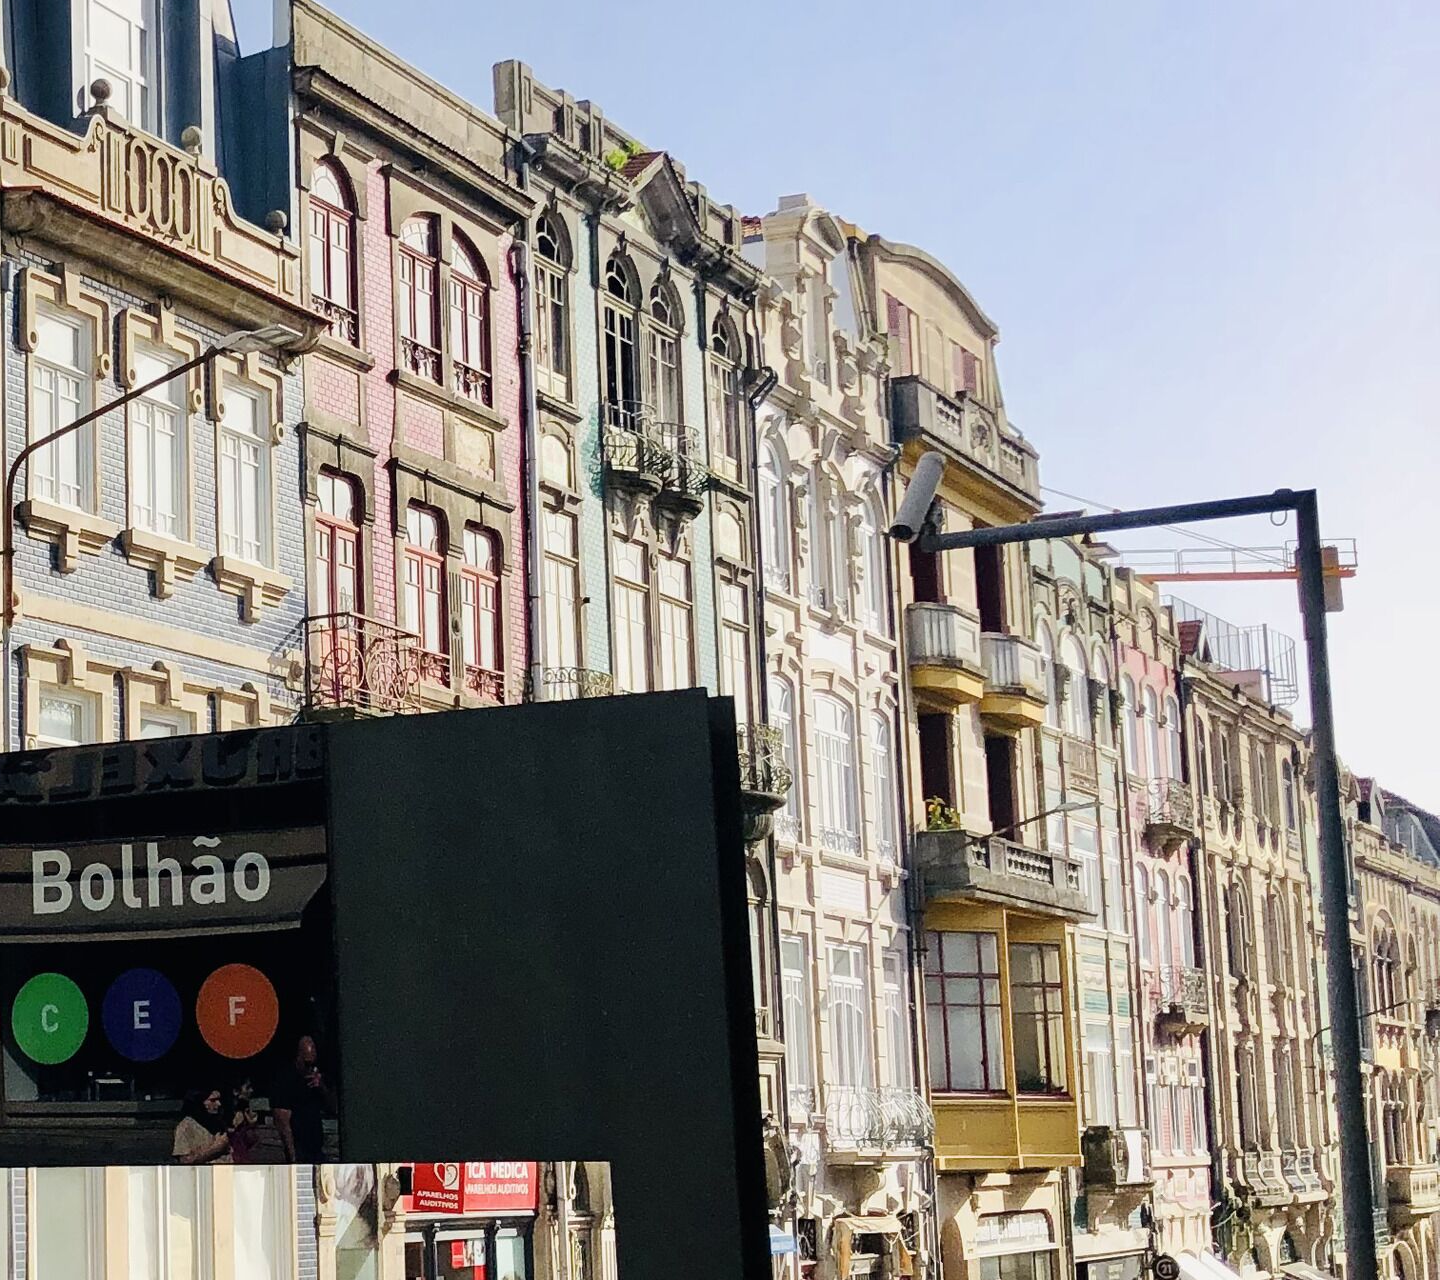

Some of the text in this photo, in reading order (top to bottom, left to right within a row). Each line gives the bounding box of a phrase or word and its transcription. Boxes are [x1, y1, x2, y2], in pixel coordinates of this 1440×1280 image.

[32, 836, 271, 915] Bolhão
[41, 1004, 59, 1033] C
[133, 1000, 151, 1030] E
[228, 996, 246, 1026] F
[417, 1190, 459, 1201] APARELHOS
[419, 1199, 459, 1210] AUDITIVOS
